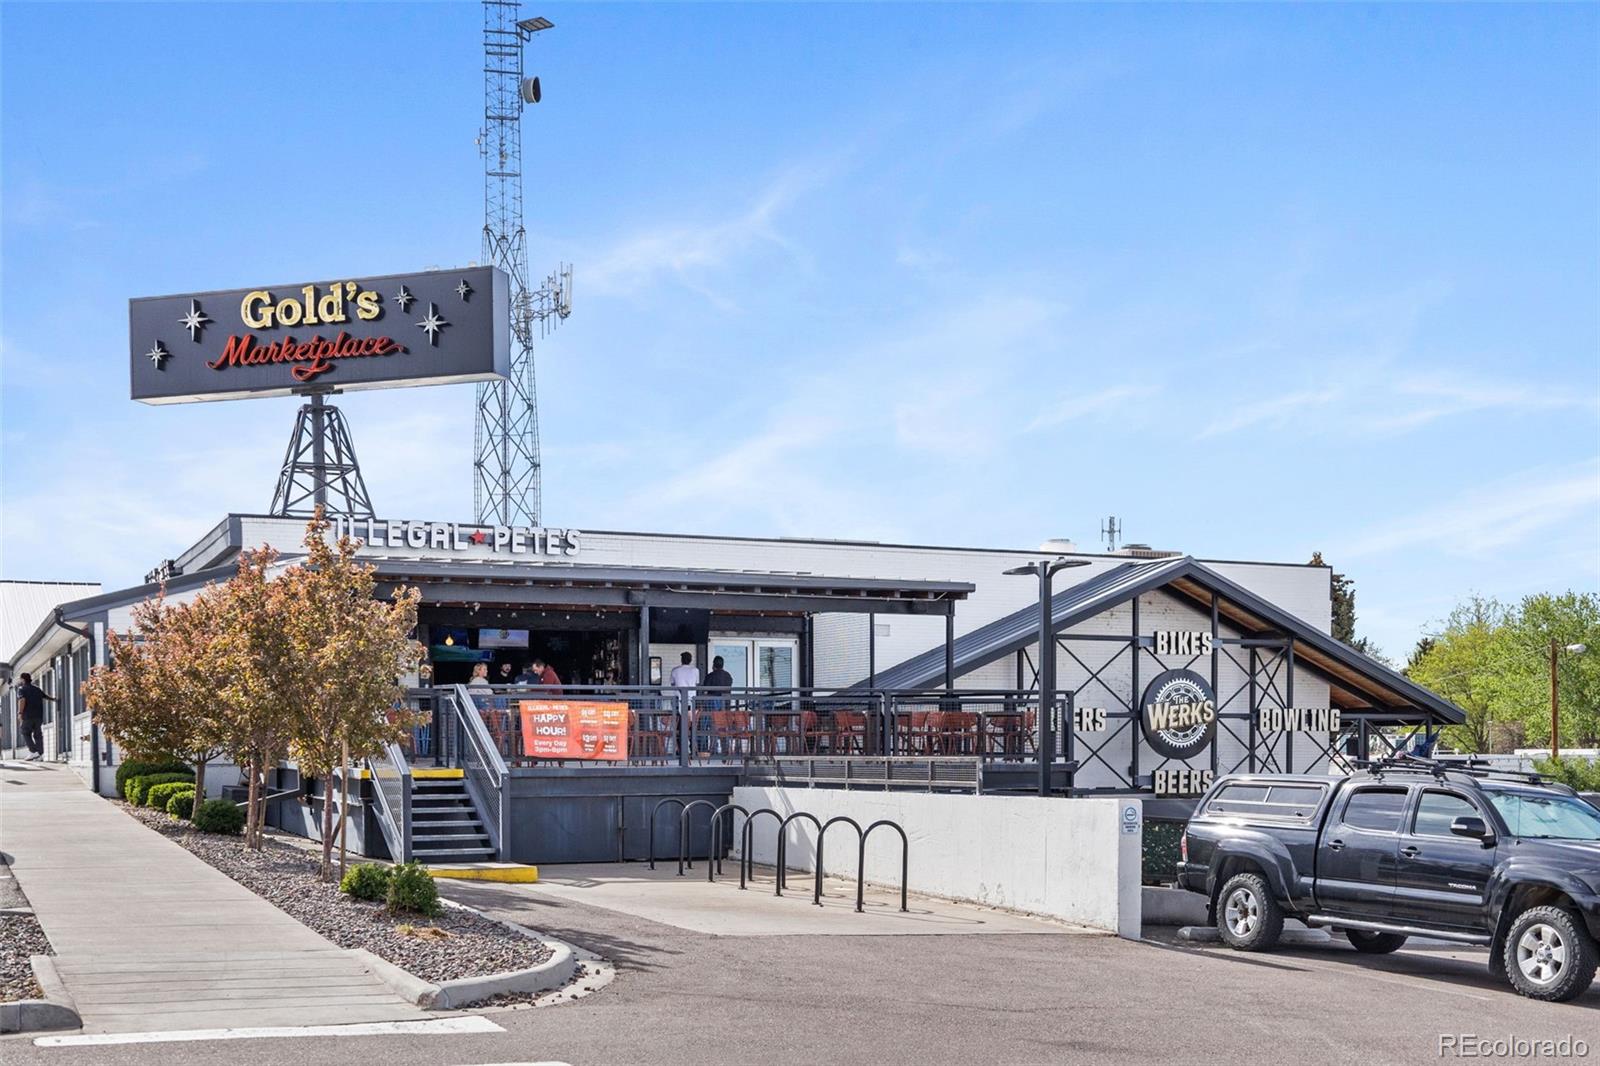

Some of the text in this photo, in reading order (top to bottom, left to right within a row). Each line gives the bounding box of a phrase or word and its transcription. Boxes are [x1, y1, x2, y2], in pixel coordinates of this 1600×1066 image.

[241, 281, 381, 328] Gold's
[206, 332, 406, 382] Marketplace
[336, 516, 581, 556] ILLEGAL PETE'S
[1155, 631, 1213, 655] BIKES
[1173, 694, 1189, 704] THE
[533, 713, 565, 723] HAPPY
[1259, 708, 1341, 732] BOWLING
[534, 739, 553, 747] Every
[536, 726, 567, 736] HOUR!
[1155, 770, 1213, 794] BEERS
[1447, 882, 1477, 891] TACOMA
